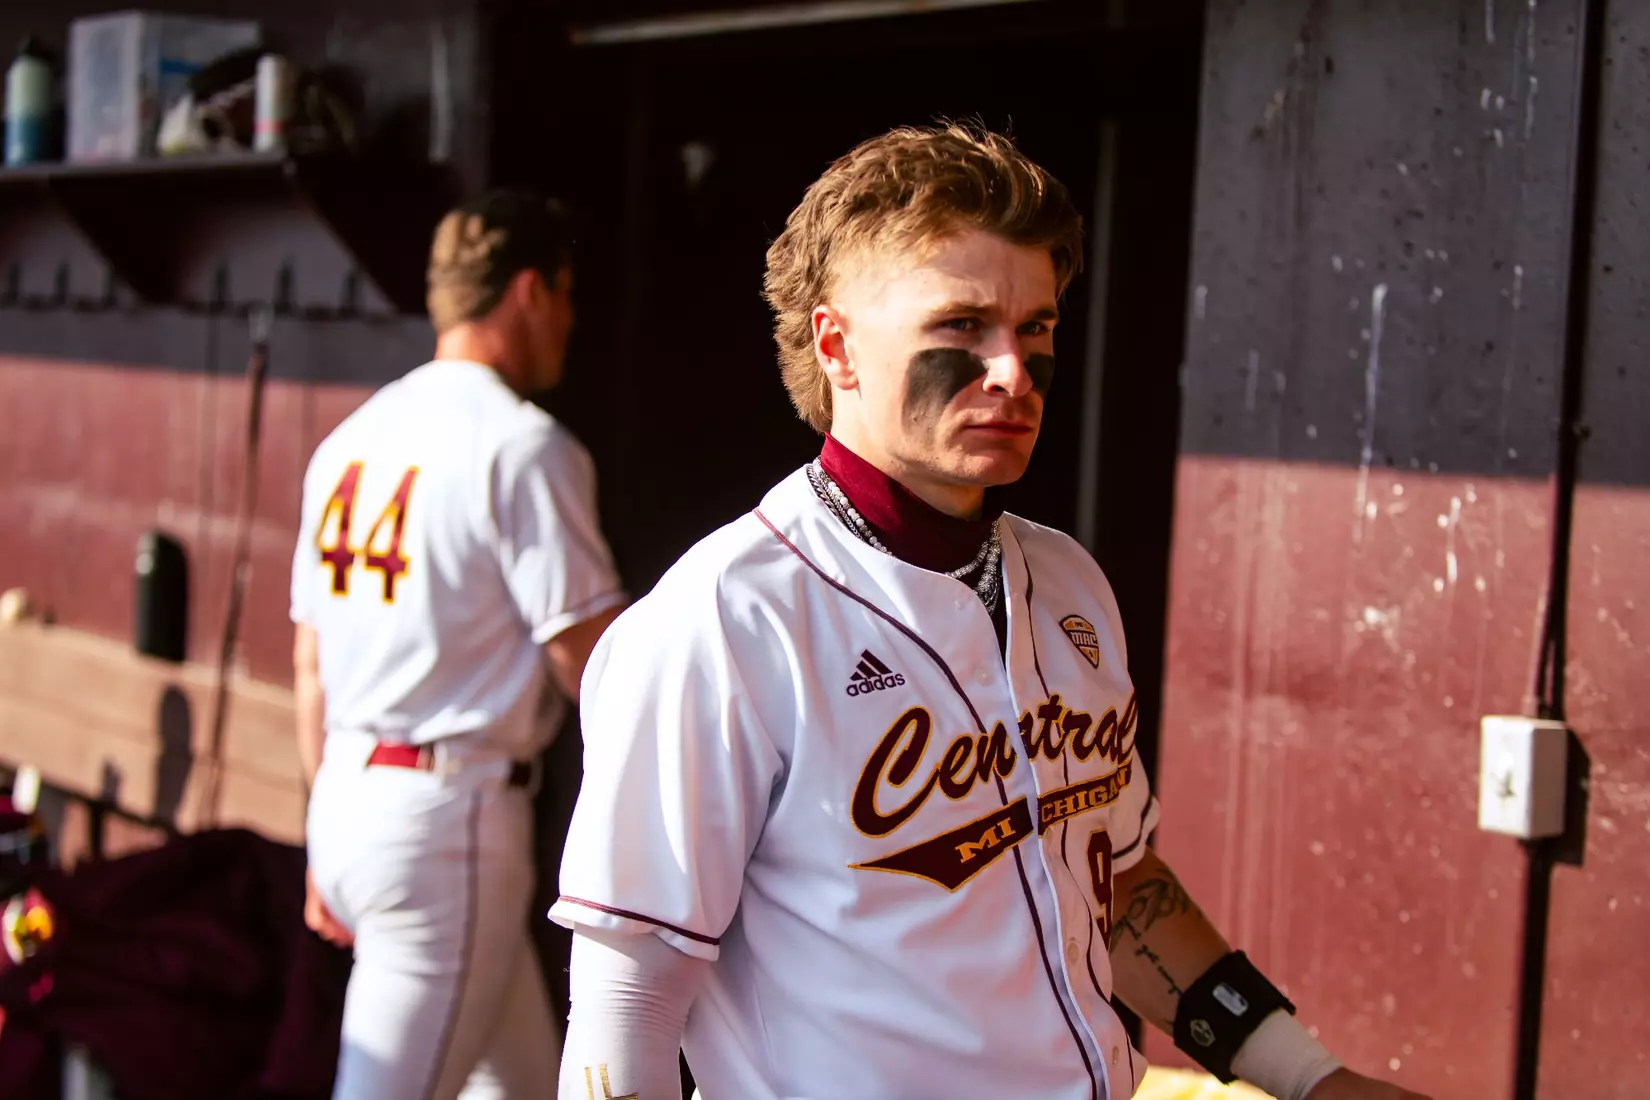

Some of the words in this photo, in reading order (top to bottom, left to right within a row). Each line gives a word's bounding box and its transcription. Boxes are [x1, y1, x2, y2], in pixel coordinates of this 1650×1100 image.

[315, 461, 420, 604] 44
[1070, 631, 1098, 646] MAC
[846, 673, 906, 697] adidas
[851, 691, 1138, 838] Central
